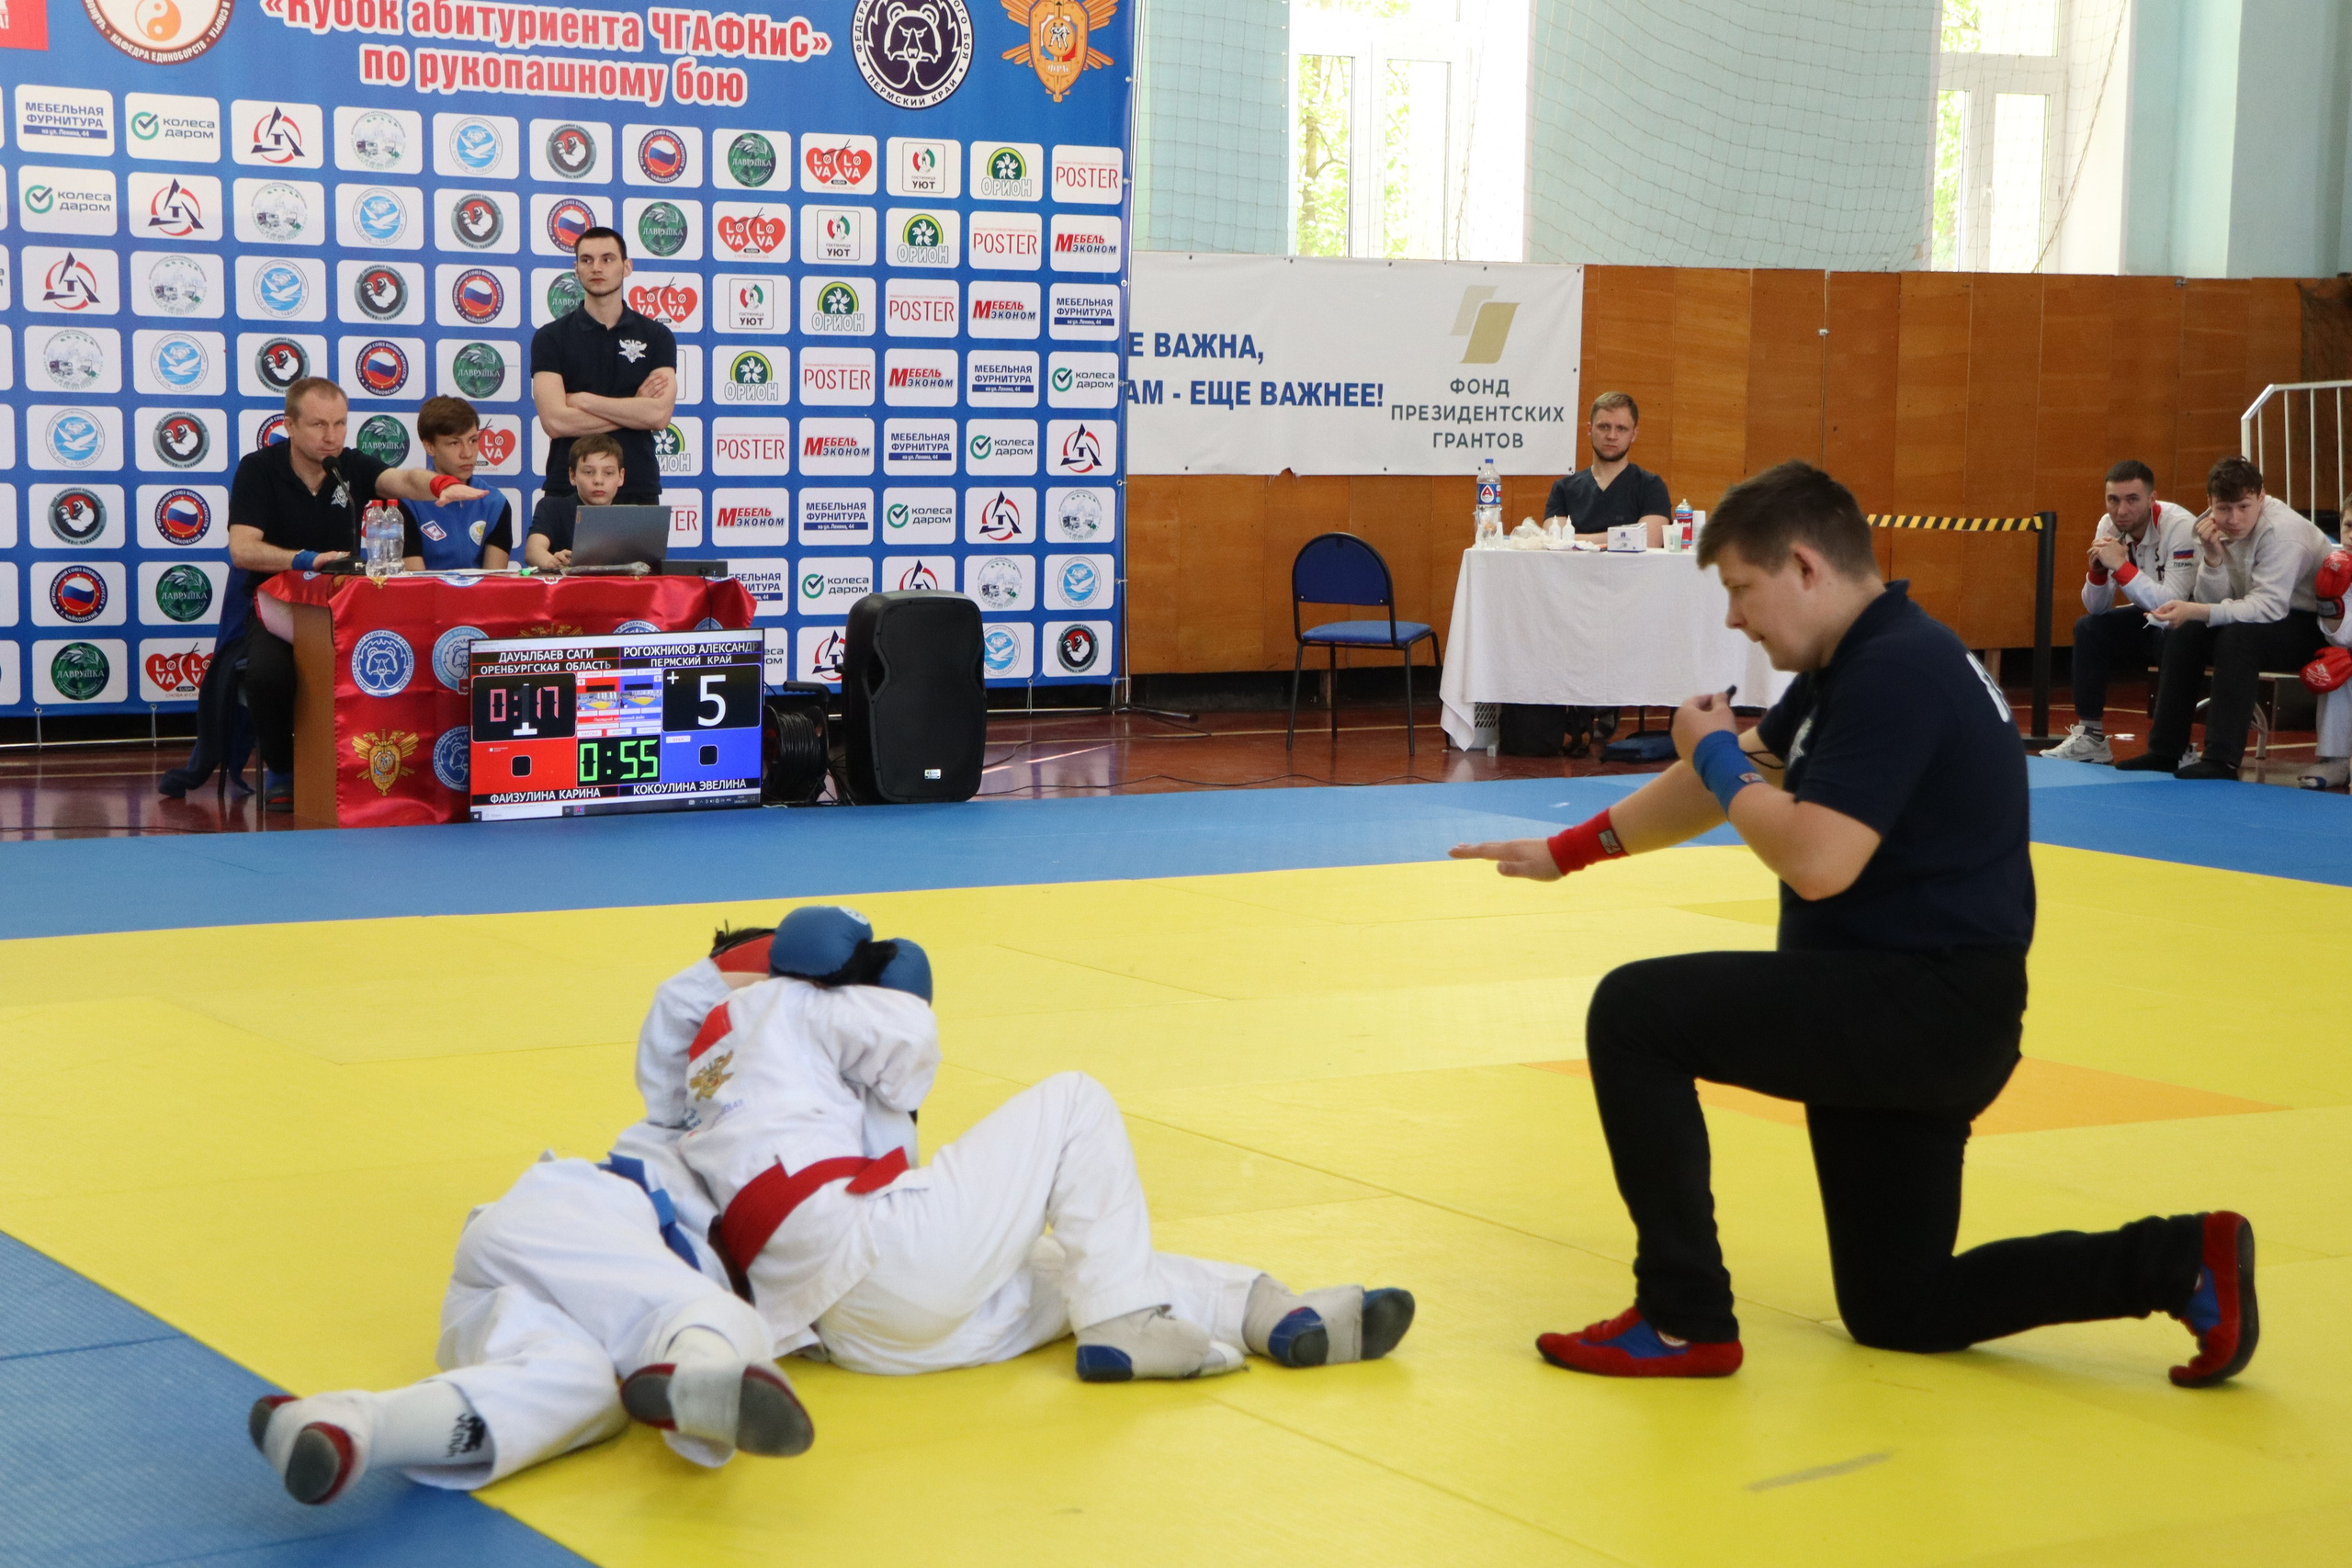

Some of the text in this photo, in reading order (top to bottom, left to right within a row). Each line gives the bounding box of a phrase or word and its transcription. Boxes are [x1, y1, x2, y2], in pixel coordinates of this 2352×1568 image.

[413, 0, 640, 47] абитуриента
[651, 12, 828, 58] ЧГАФКиС»
[110, 34, 207, 63] КАФЕДРА ЕДИНОБОРСТВ
[364, 49, 743, 102] по рукопашному бою
[867, 74, 957, 107] ПЕРМСКИЙ КРАЙ
[25, 102, 104, 116] МЕБЕЛЬНАЯ
[27, 114, 103, 128] ФУРНИТУРА
[164, 118, 215, 129] колеса
[165, 129, 214, 140] даром
[732, 157, 772, 167] ЛАВРУШКА
[1057, 166, 1118, 189] POSTER
[912, 181, 935, 189] УЮТ
[58, 191, 112, 202] колеса
[60, 201, 110, 212] даром
[643, 227, 684, 237] ЛАВРУШКА
[973, 232, 1037, 255] POSTER
[827, 248, 851, 257] УЮТ
[552, 298, 580, 306] ЛАВРУ
[1056, 298, 1114, 308] МЕБЕЛЬНАЯ
[889, 299, 955, 321] POSTER
[1057, 307, 1113, 317] ФУРНИТУРА
[740, 317, 763, 326] УЮТ
[1154, 333, 1264, 364] ВАЖНА,
[458, 369, 500, 378] ЛАВРУШКА
[975, 365, 1033, 373] МЕБЕЛЬНАЯ
[804, 369, 871, 390] POSTER
[975, 374, 1031, 383] ФУРНИТУРА
[1076, 371, 1115, 379] колеса
[1077, 380, 1114, 389] даром
[1450, 378, 1510, 398] ФОНД
[1191, 381, 1251, 410] ЕЩЕ
[1261, 382, 1384, 408] ВАЖНЕЕ!
[1391, 405, 1565, 423] ПРЕЗИДЕНТСКИХ
[362, 441, 405, 450] ЛАВРУШКА
[995, 438, 1035, 446] колеса
[1432, 432, 1524, 449] ГРАНТОВ
[717, 439, 785, 460] POSTER
[891, 443, 949, 451] ФУРНИТУРА
[996, 447, 1033, 456] даром
[659, 453, 691, 472] ИОН
[806, 502, 866, 511] МЕБЕЛЬНАЯ
[807, 512, 865, 521] ФУРНИТУРА
[912, 516, 951, 525] даром
[827, 577, 869, 585] колеса
[162, 592, 208, 600] ЛАВРУШКА
[828, 586, 868, 595] даром
[499, 649, 594, 663] ДАУЫЛБАЕВ САГИ
[624, 646, 695, 657] РОГОЖНИКОВ
[650, 654, 732, 667] ПЕРМСКИЙ КРАЙ
[481, 660, 611, 674] ОРЕНБУРГСКАЯ ОБЛАСТЬ
[57, 670, 105, 679] ЛАВРУШКА
[698, 674, 726, 727] 5
[580, 739, 658, 782] 0:55
[633, 778, 747, 795] КОКОУЛИНА ЭВЕЛИНА
[491, 788, 601, 804] ФАЙЗУЛИНА КАРИНА
